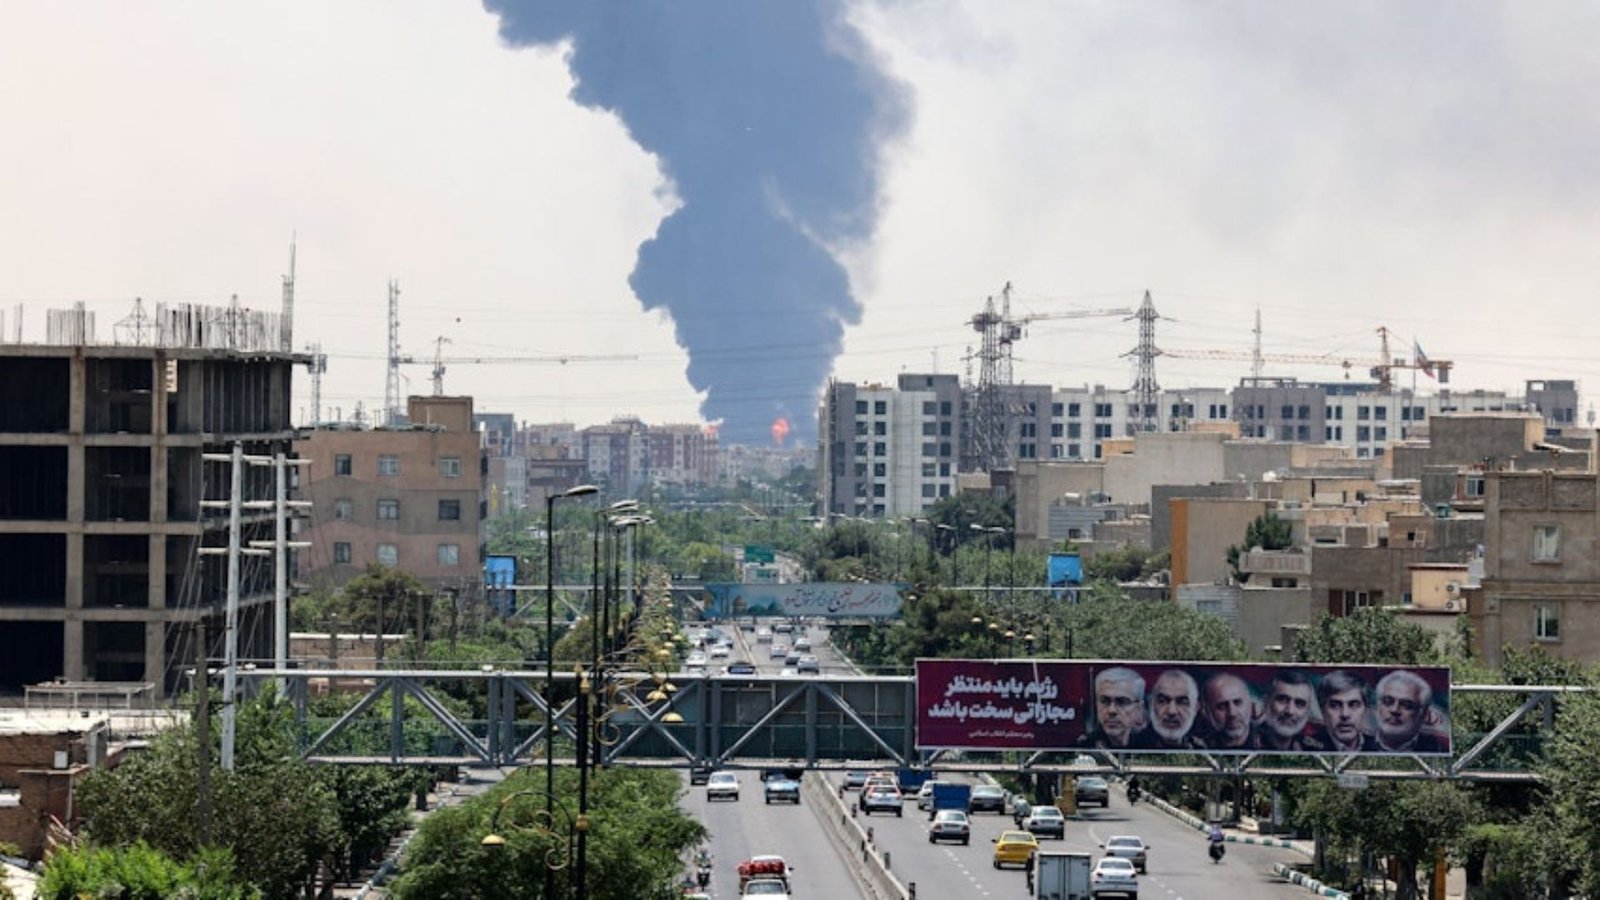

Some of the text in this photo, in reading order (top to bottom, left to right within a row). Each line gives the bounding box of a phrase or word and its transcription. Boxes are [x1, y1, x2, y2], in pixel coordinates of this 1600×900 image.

[945, 674, 1058, 699] رژیم باید منتظر
[928, 699, 1075, 724] مجازاتی سخت باشد
